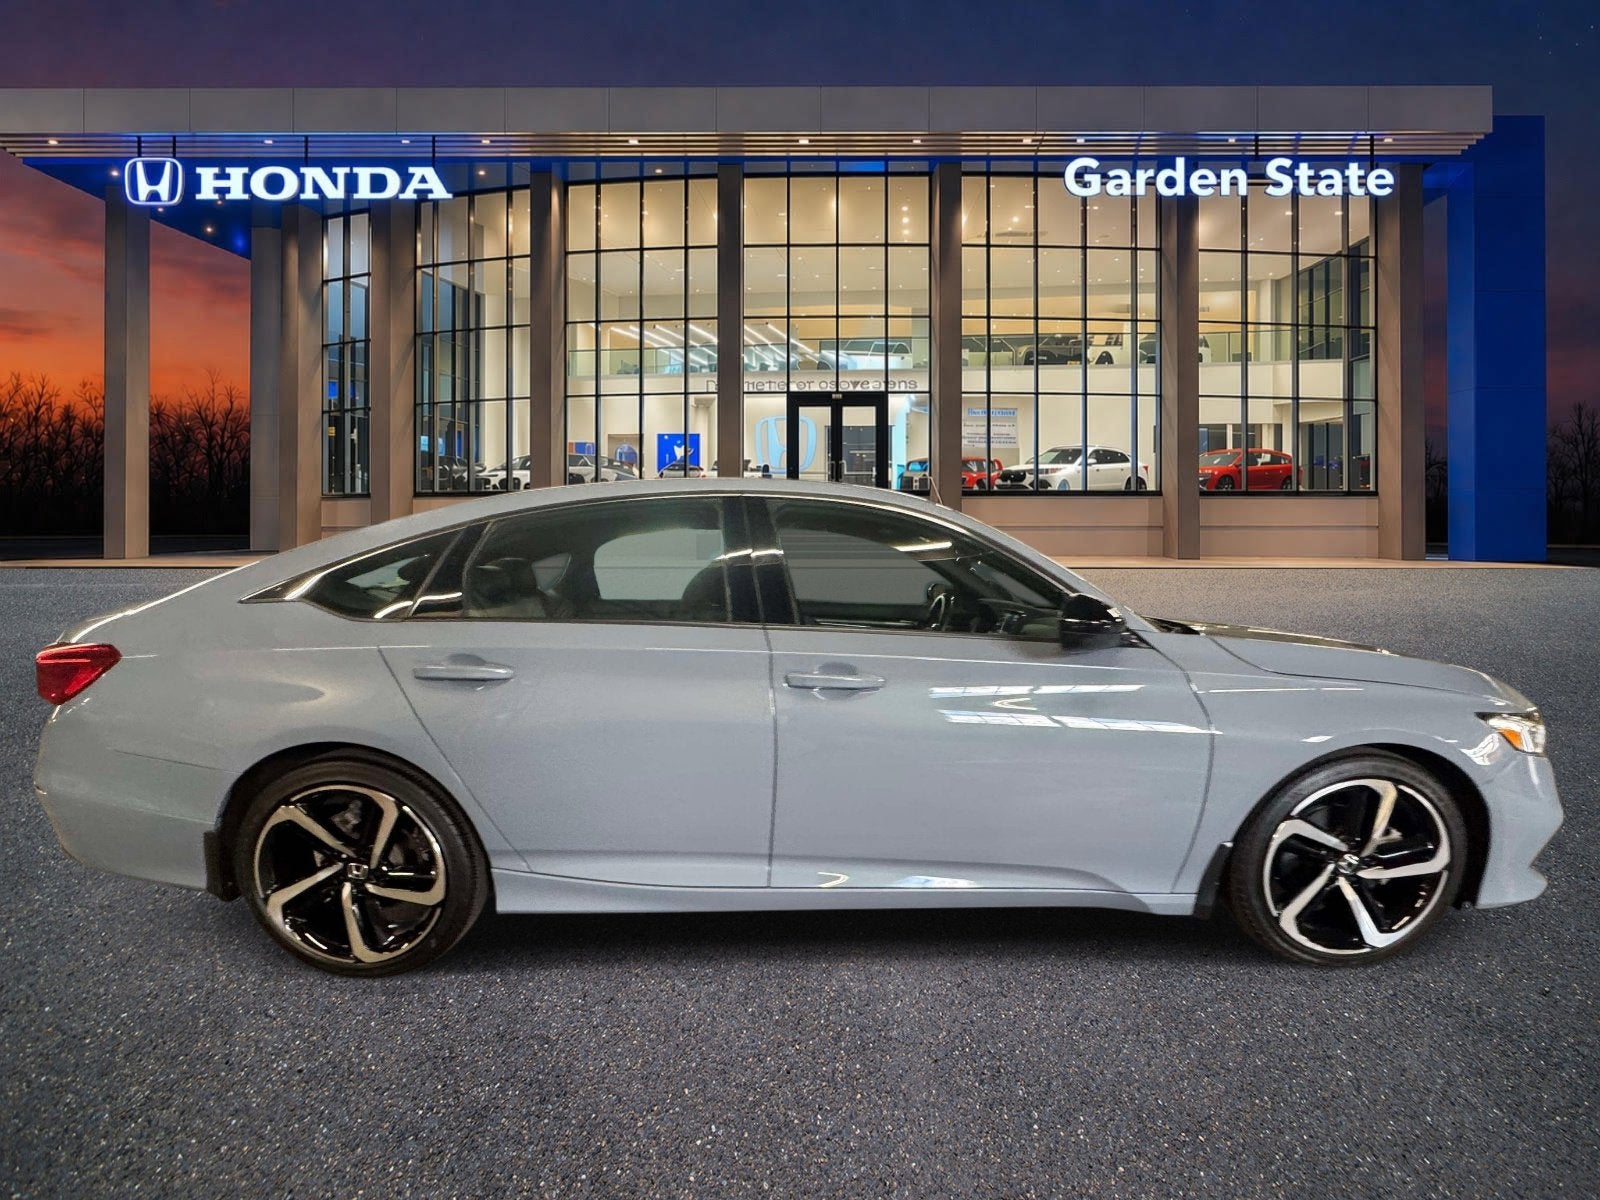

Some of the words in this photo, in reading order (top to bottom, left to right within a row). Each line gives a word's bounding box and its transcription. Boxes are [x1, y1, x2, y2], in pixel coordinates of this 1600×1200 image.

[195, 166, 453, 201] HONDA
[1064, 157, 1248, 197] Garden
[1264, 157, 1395, 197] State
